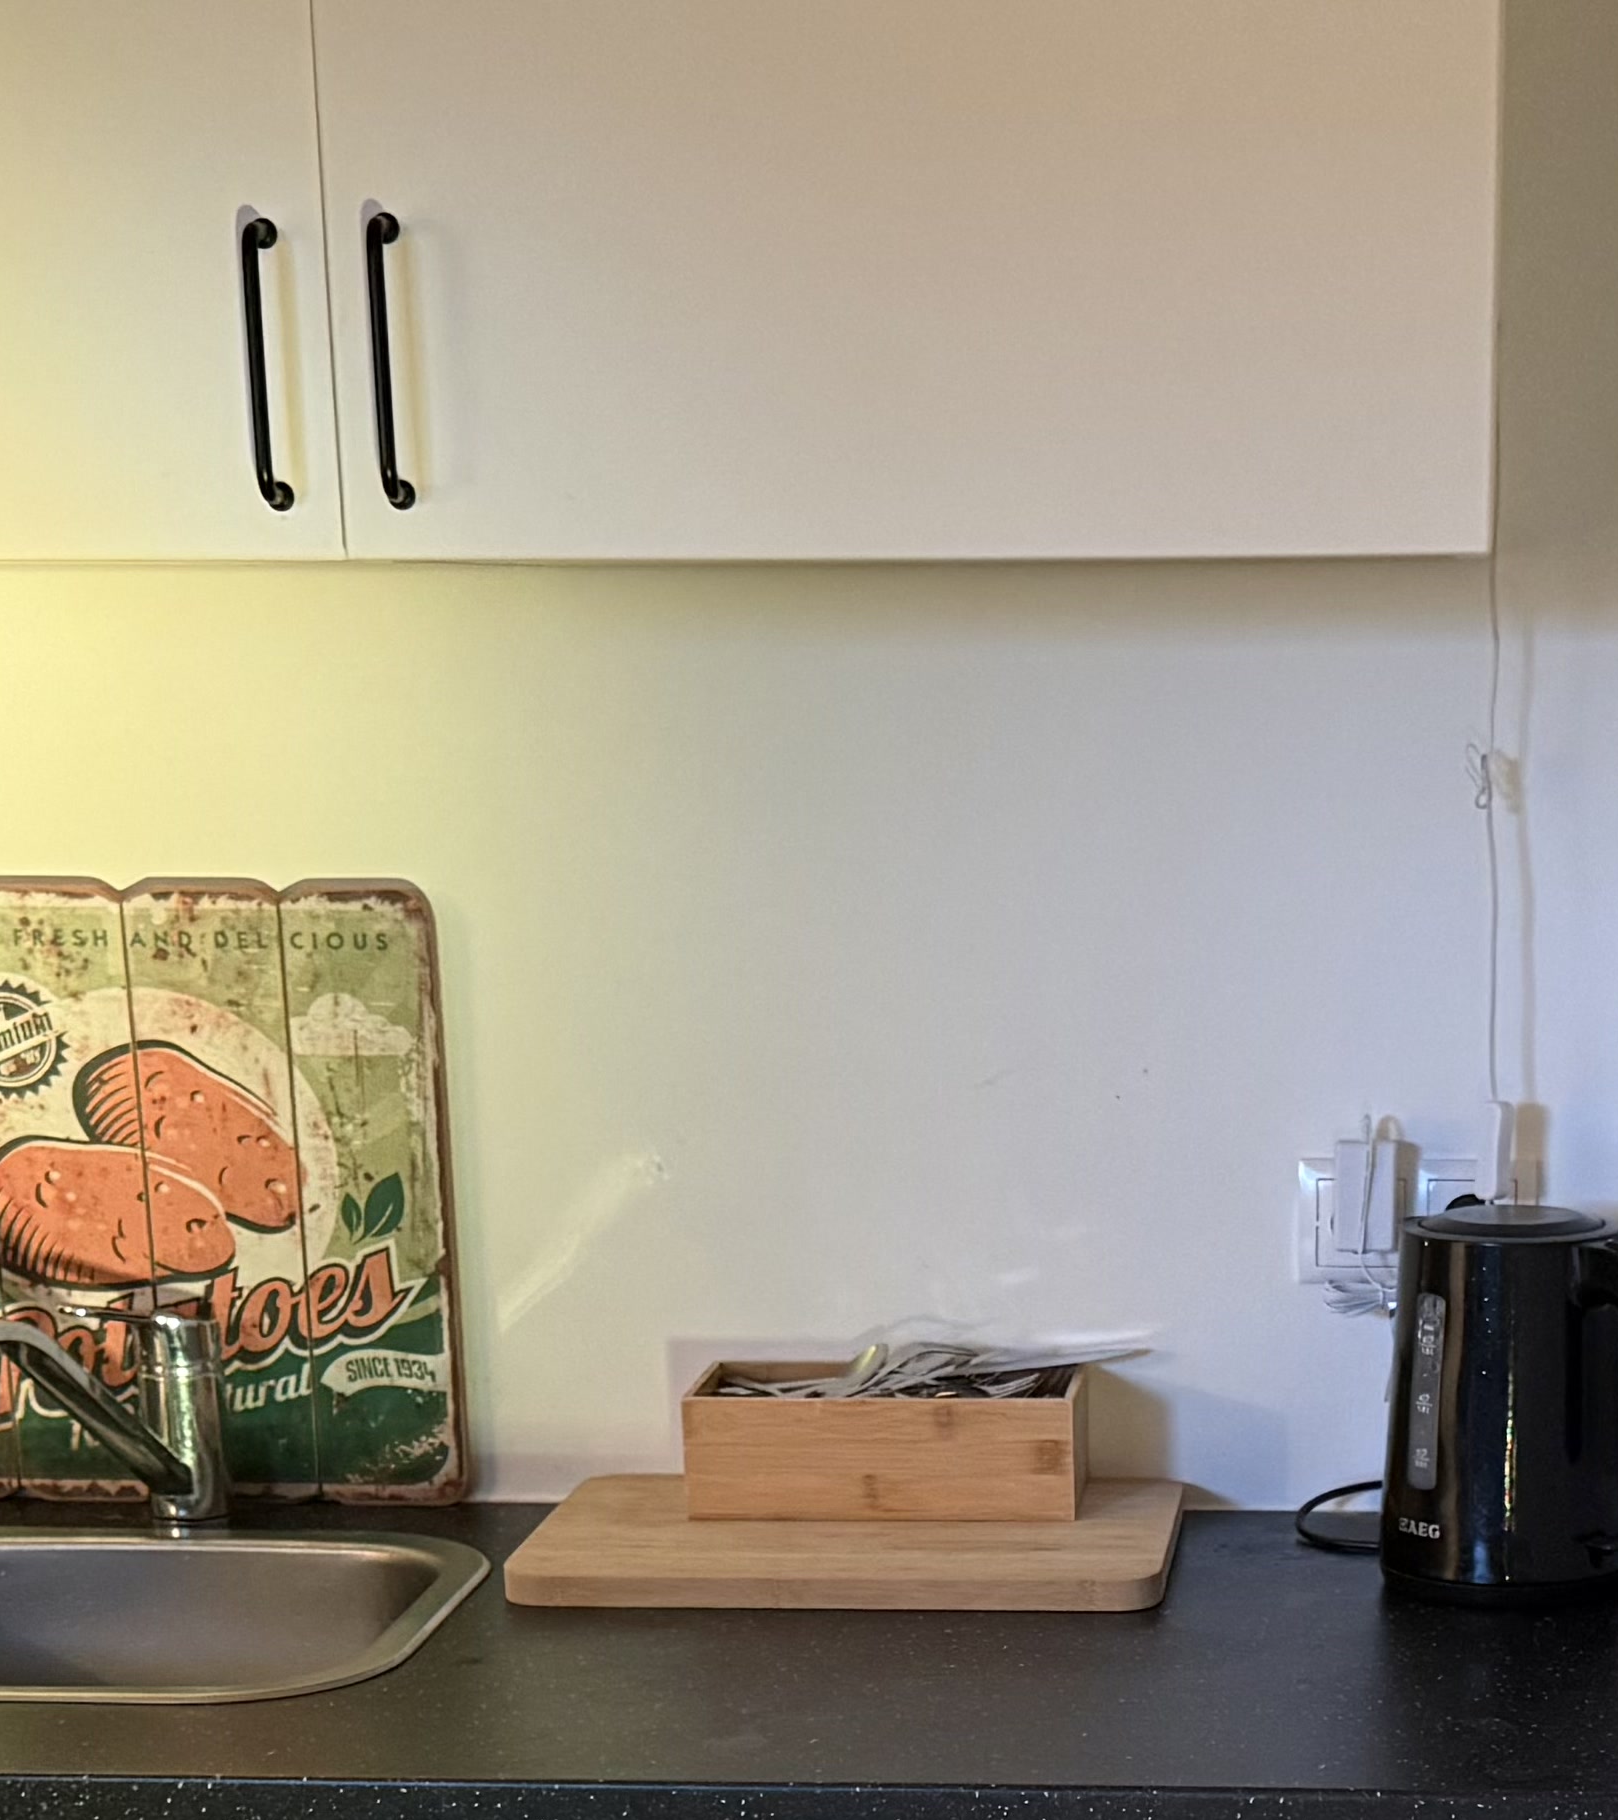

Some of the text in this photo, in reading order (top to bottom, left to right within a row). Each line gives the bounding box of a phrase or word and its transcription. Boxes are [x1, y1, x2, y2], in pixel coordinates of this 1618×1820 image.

[13, 929, 108, 947] FRESH
[130, 930, 193, 948] AND
[214, 930, 389, 951] DELCIOUS
[346, 1357, 436, 1382] SINCE 1934
